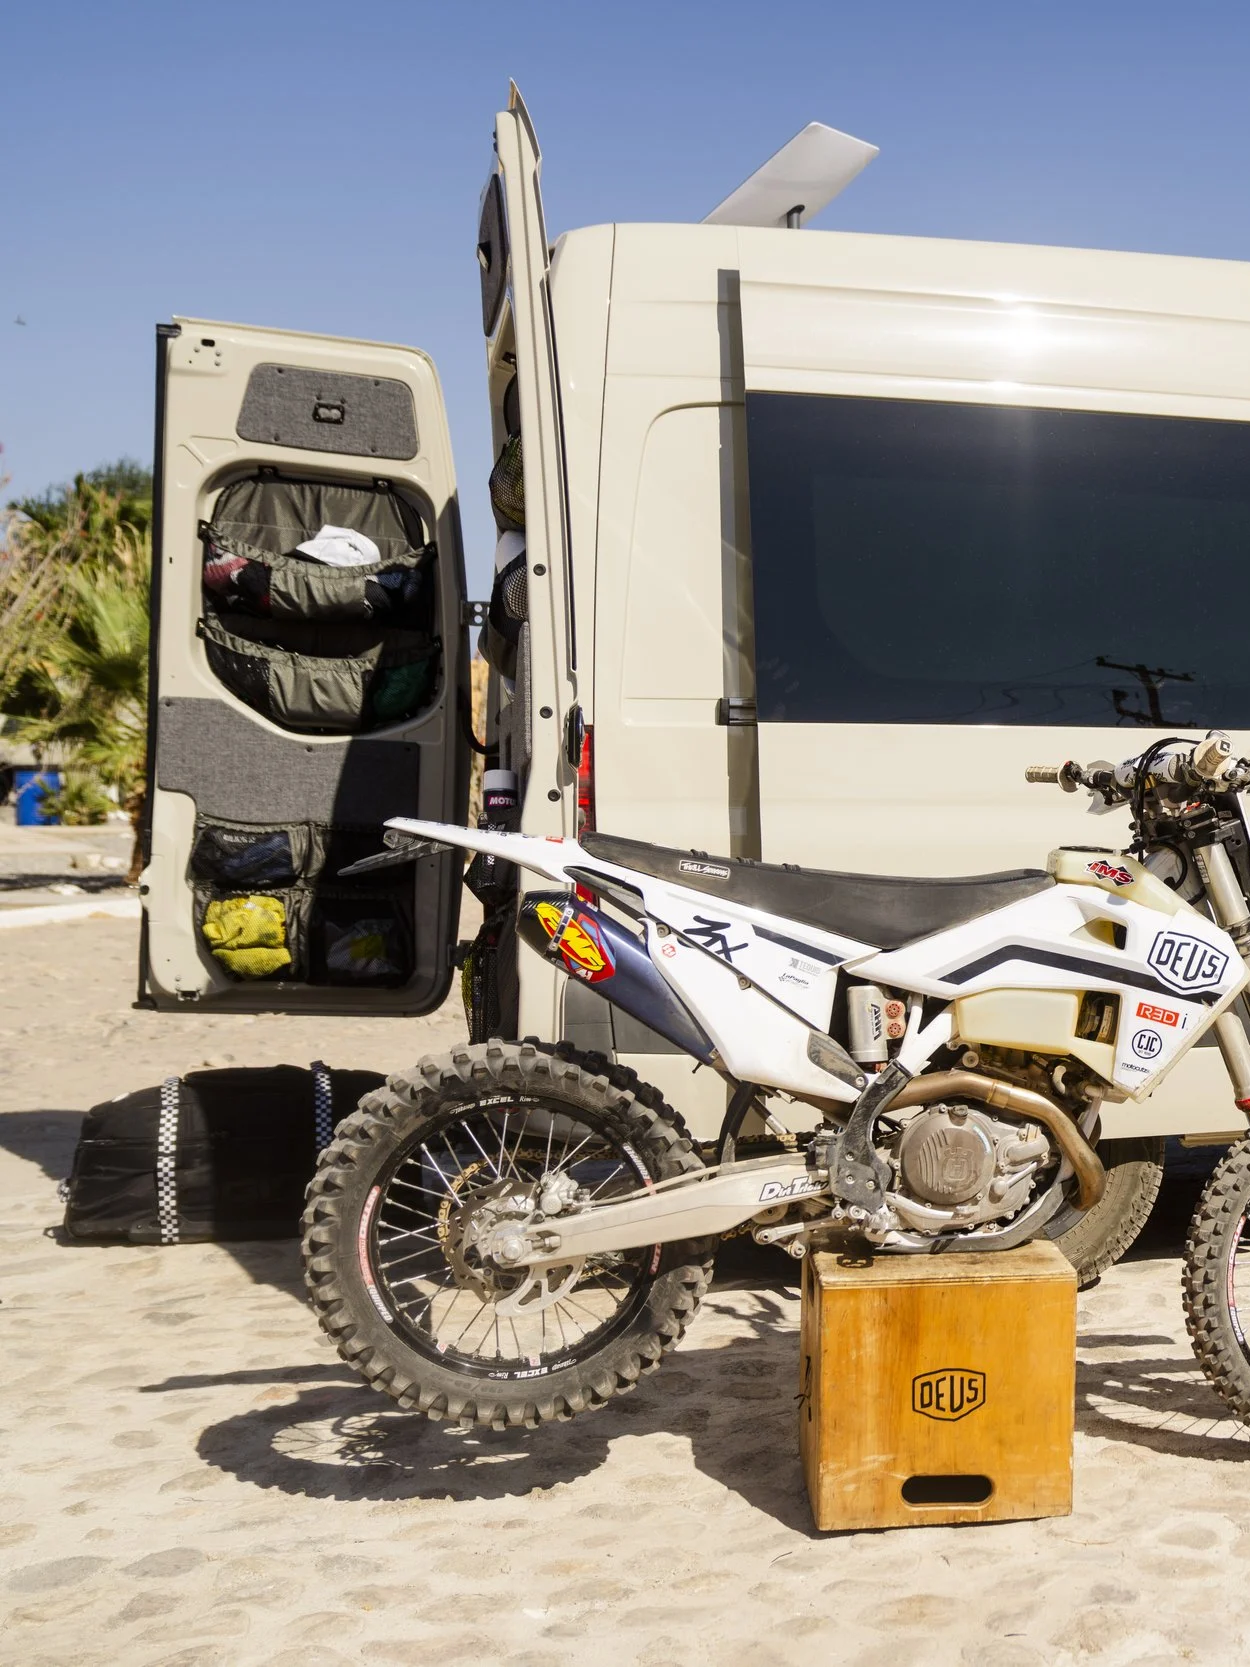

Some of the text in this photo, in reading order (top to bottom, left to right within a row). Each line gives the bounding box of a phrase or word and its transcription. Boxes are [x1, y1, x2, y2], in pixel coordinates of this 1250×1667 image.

[489, 796, 516, 806] MOTU
[1089, 861, 1133, 884] IMS
[1155, 938, 1221, 982] DEUS
[1137, 1033, 1158, 1053] CJC
[479, 1096, 514, 1107] EXCEL
[513, 1366, 548, 1379] EXCEL
[920, 1375, 979, 1413] DEUS
